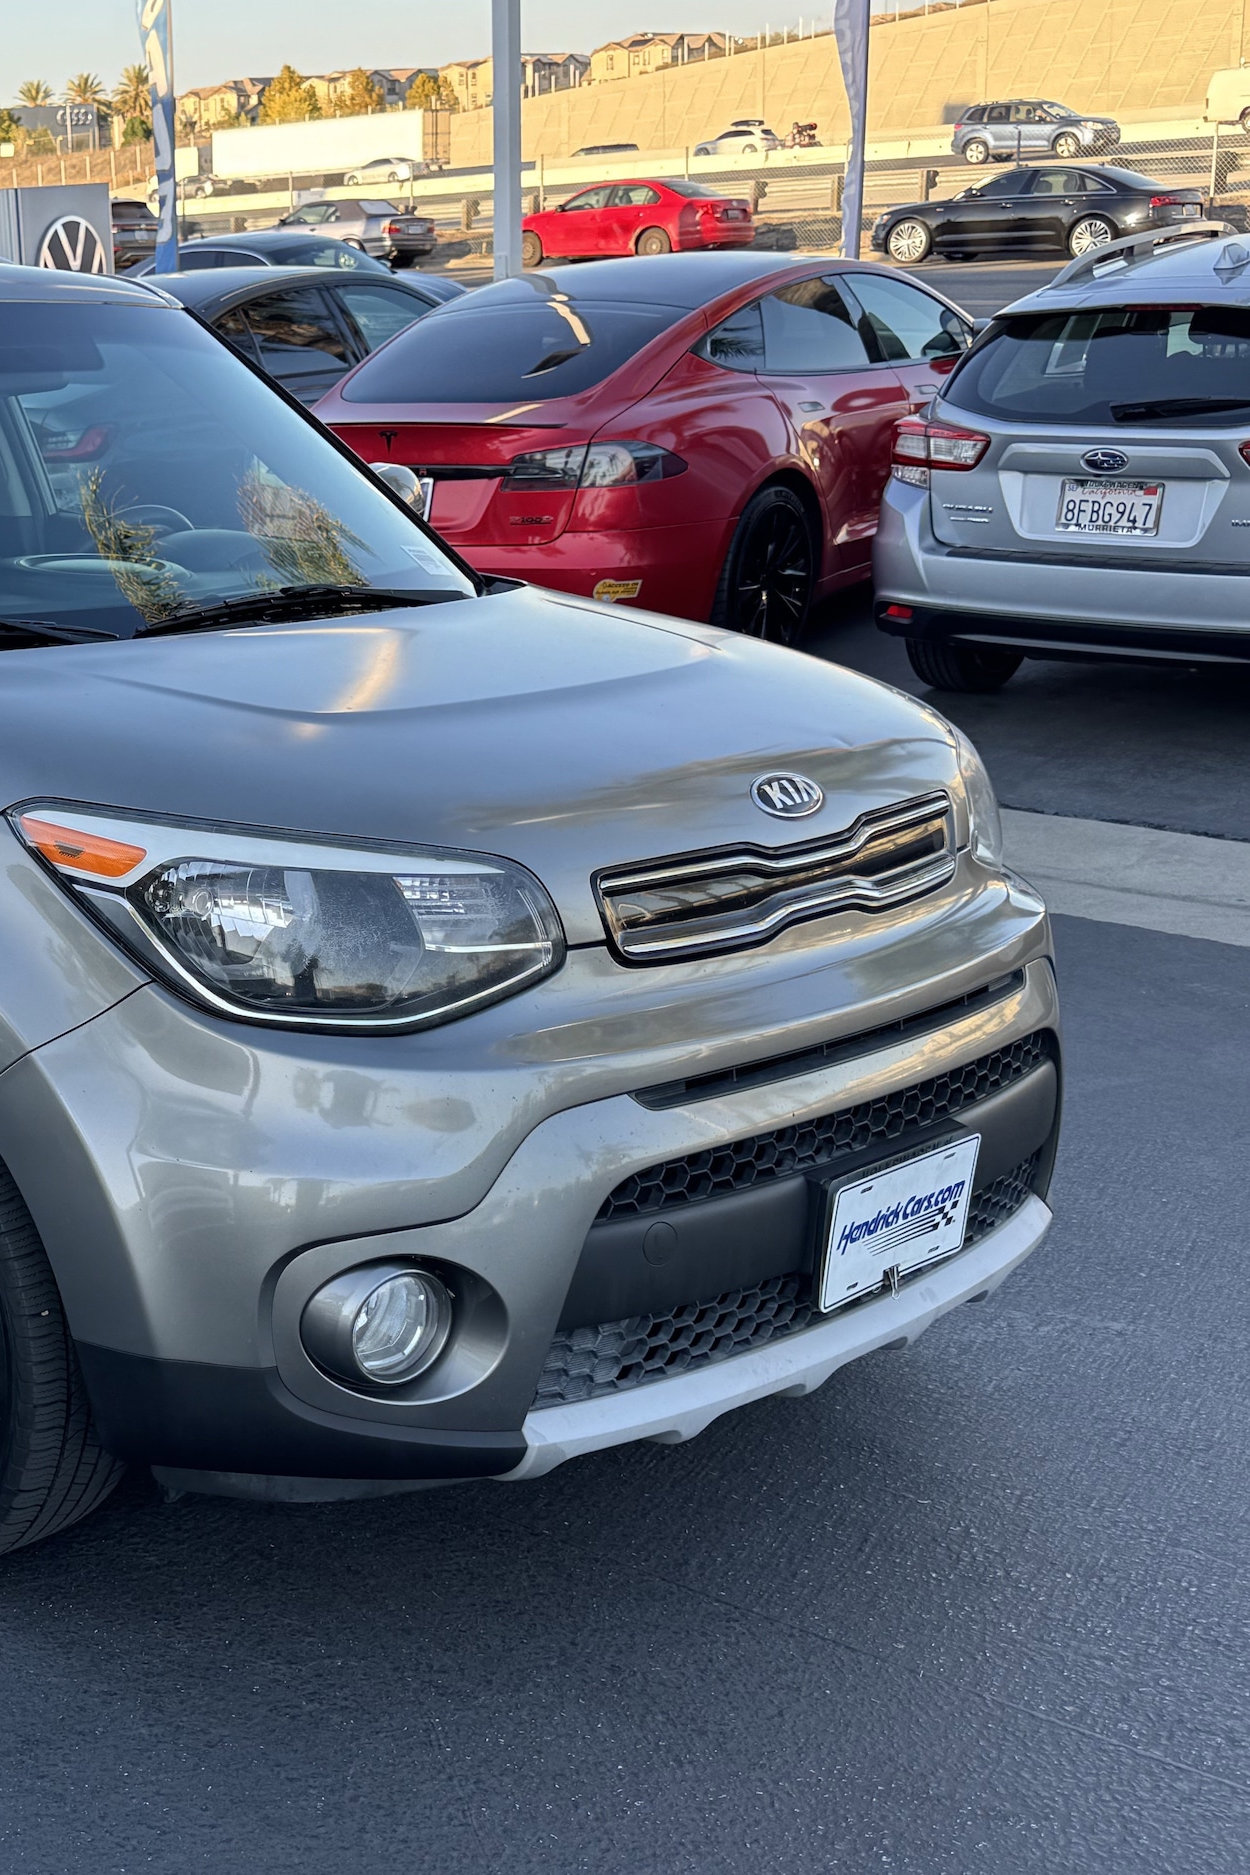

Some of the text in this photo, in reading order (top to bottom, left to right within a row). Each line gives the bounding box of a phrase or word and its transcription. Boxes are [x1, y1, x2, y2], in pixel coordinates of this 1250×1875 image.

[1064, 499, 1152, 526] 8FBG947
[1077, 523, 1133, 533] MURRIETA
[760, 778, 819, 809] KIA
